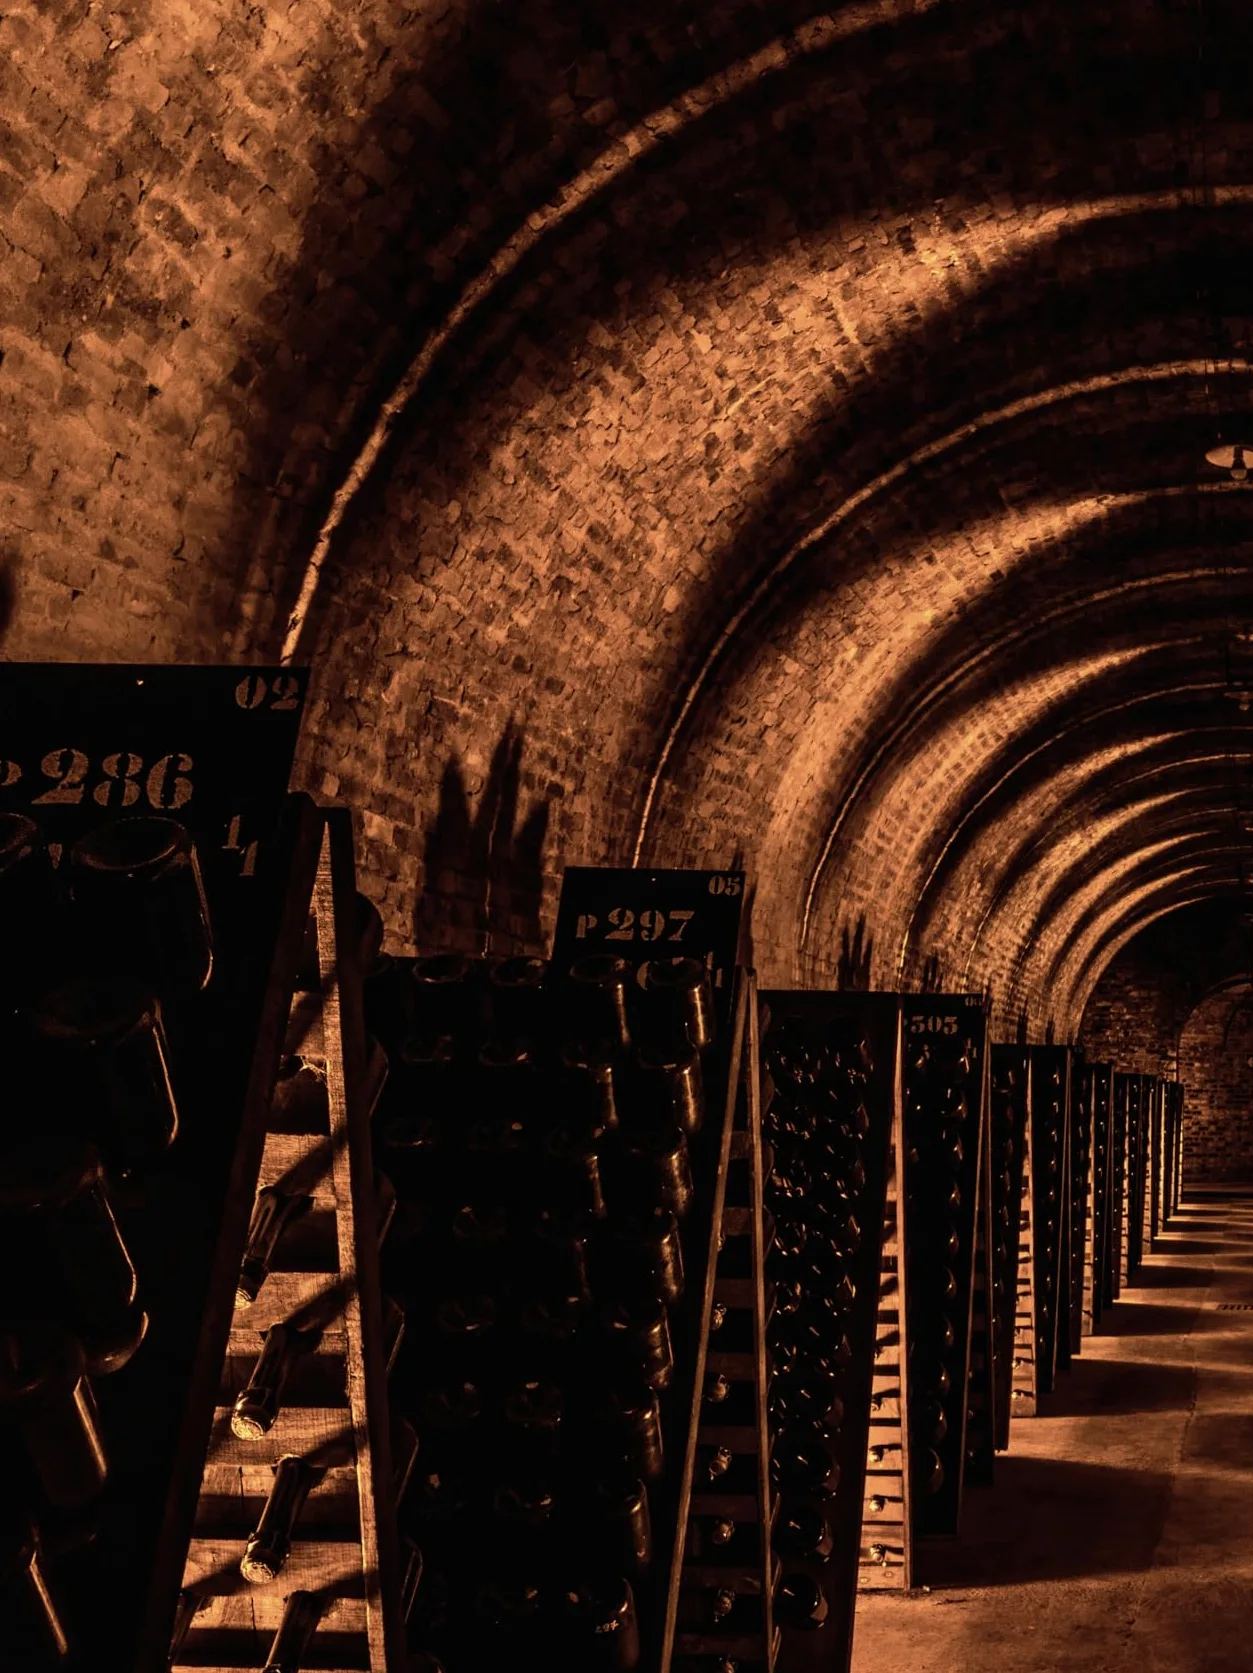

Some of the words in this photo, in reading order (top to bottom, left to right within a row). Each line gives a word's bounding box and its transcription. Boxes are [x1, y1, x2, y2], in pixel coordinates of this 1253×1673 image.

[235, 676, 299, 710] 02
[31, 748, 194, 809] 286
[709, 876, 741, 896] 05
[575, 914, 598, 939] P
[604, 907, 695, 942] 297
